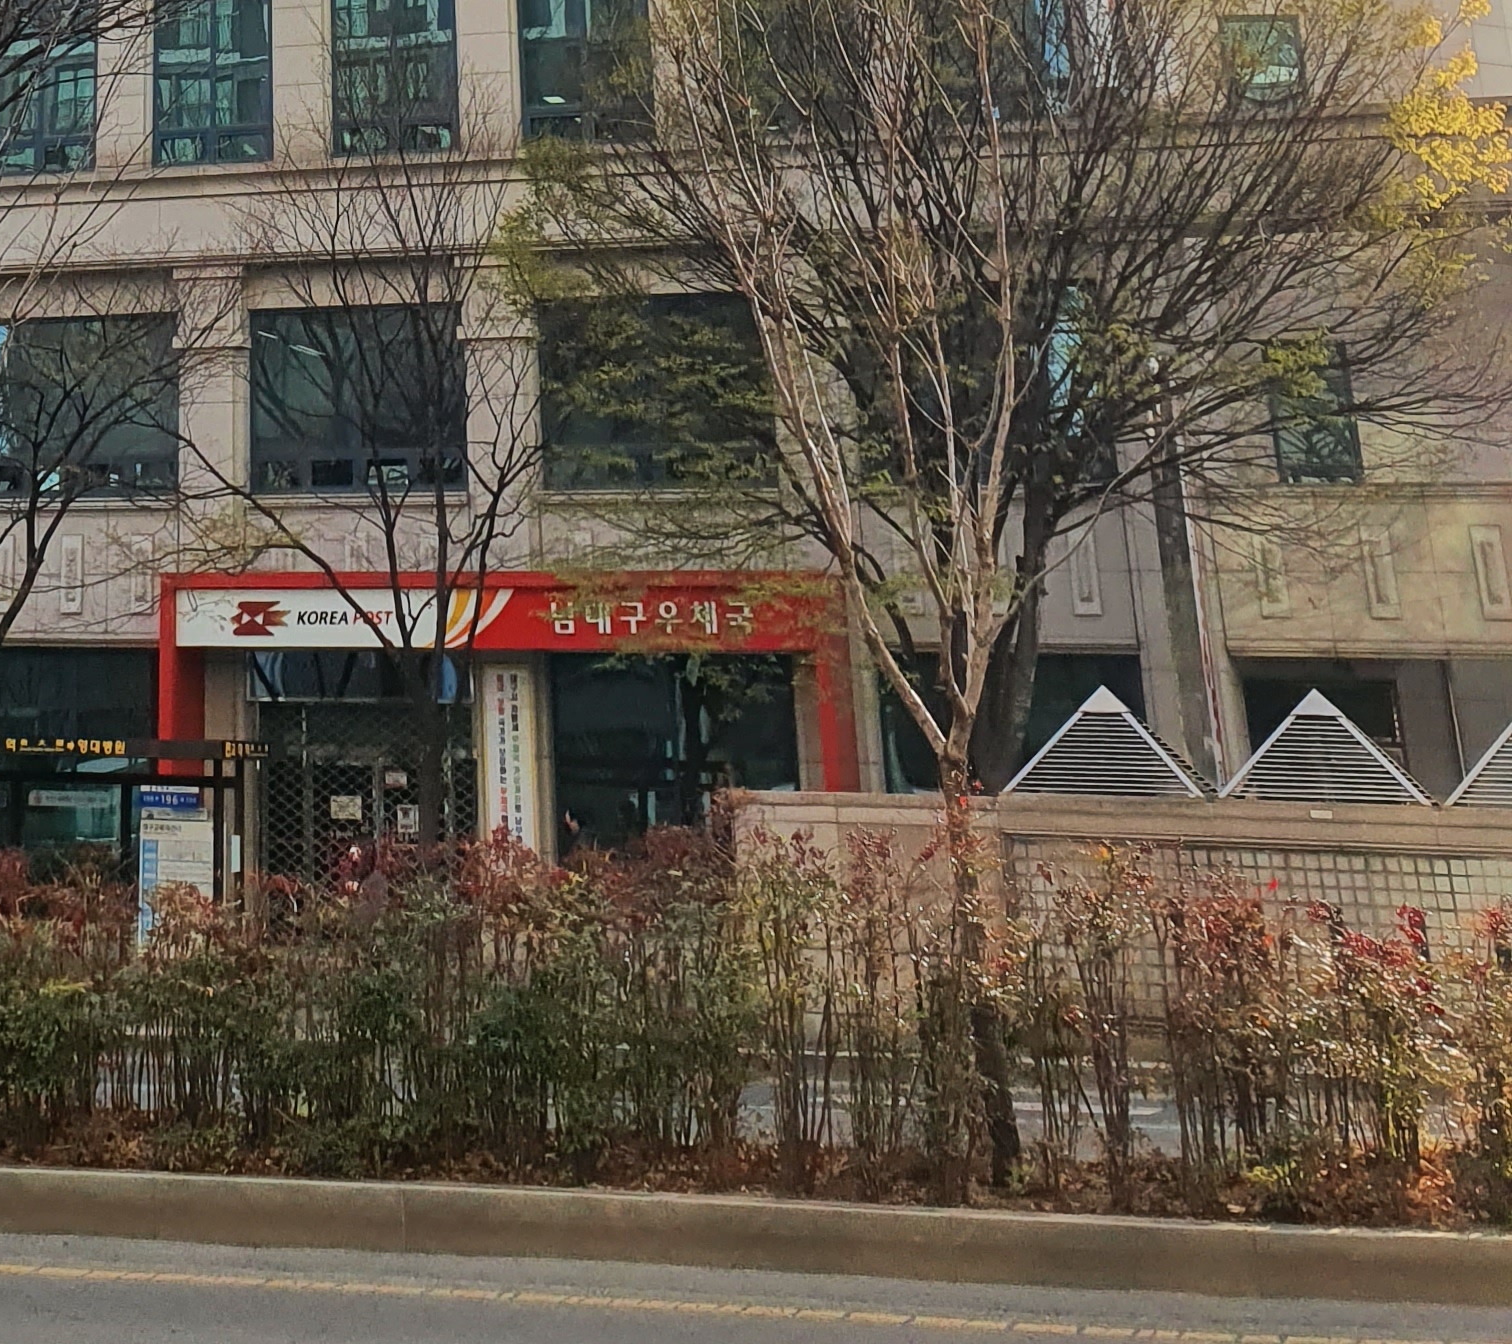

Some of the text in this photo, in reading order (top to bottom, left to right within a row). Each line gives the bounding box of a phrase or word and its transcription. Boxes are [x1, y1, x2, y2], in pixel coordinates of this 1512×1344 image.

[296, 611, 349, 625] KOREA
[550, 600, 754, 635] 남대구우체국
[77, 738, 126, 755] 영대병원
